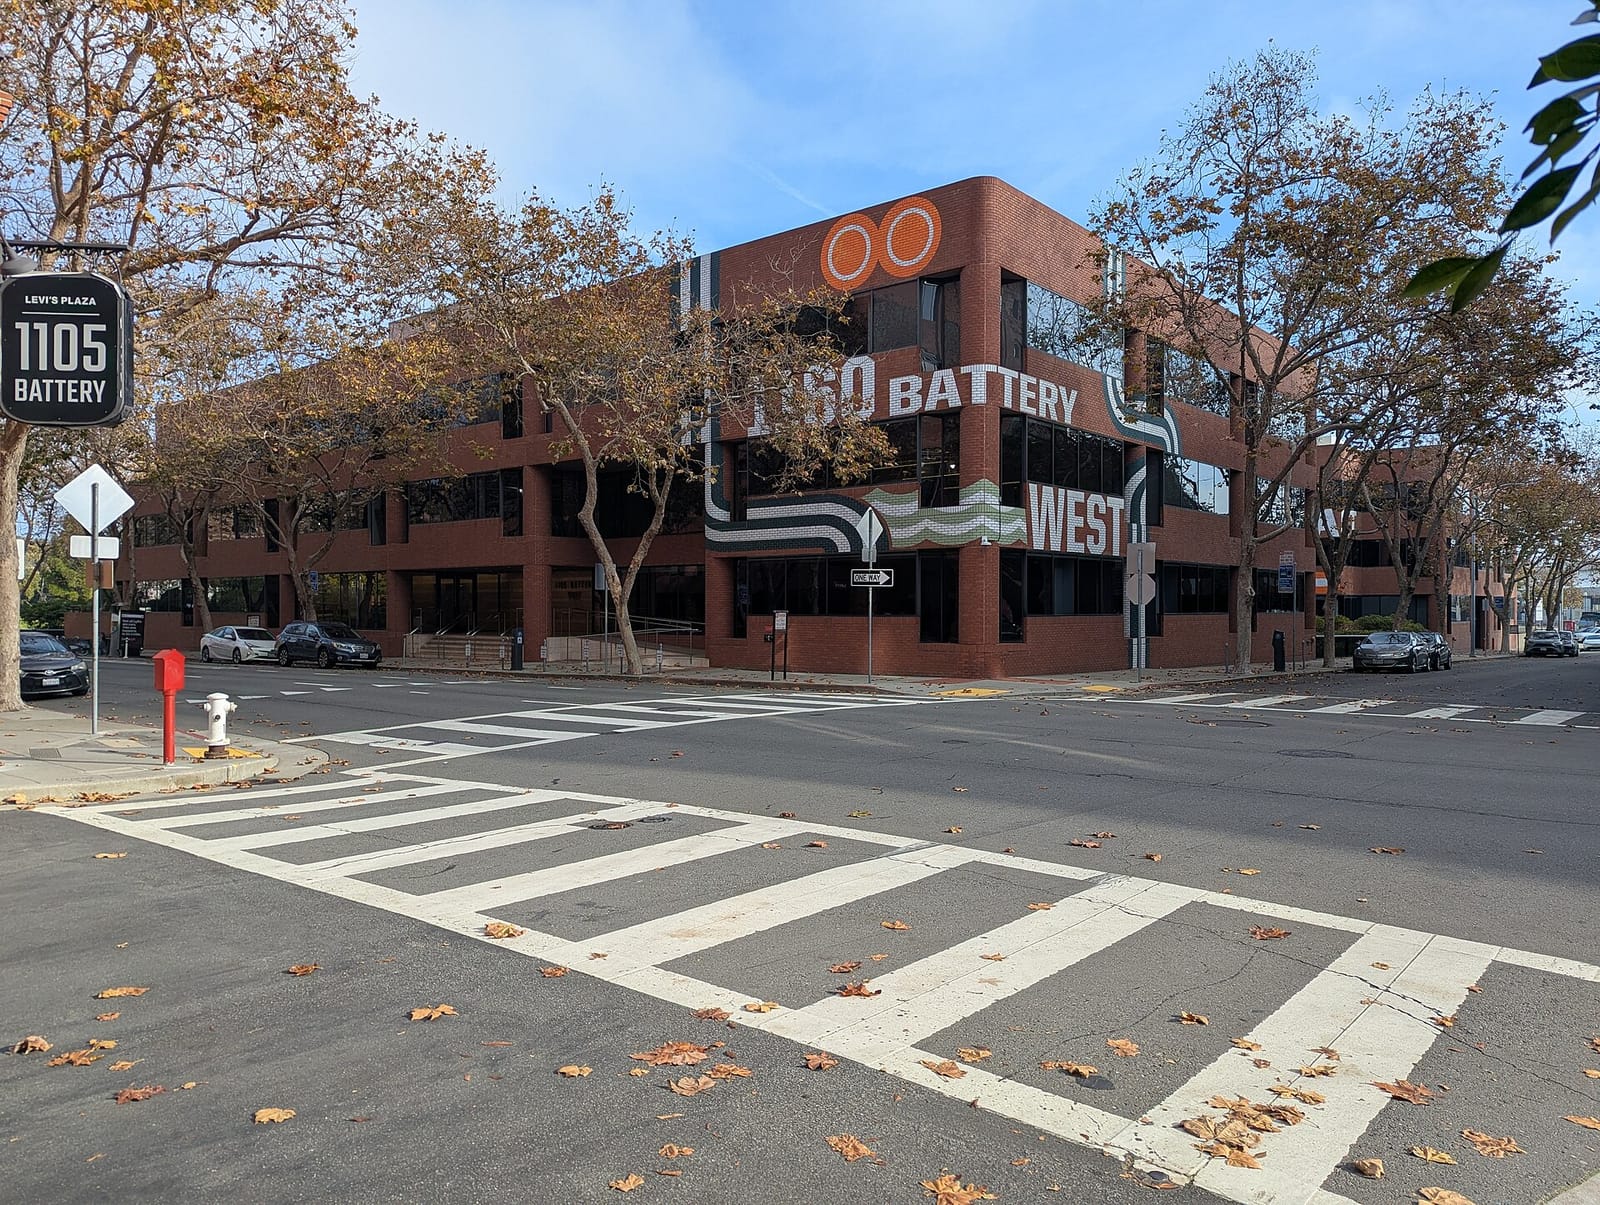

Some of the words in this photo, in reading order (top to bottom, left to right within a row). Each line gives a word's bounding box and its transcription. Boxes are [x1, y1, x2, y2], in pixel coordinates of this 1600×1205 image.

[25, 295, 58, 305] LEVI'S
[61, 296, 97, 306] PLAZA
[14, 321, 107, 372] 1105
[14, 378, 106, 403] BATTERY
[889, 363, 1078, 425] BATTERY
[1028, 482, 1125, 557] WEST
[854, 574, 867, 582] ONE
[868, 574, 880, 582] WAY
